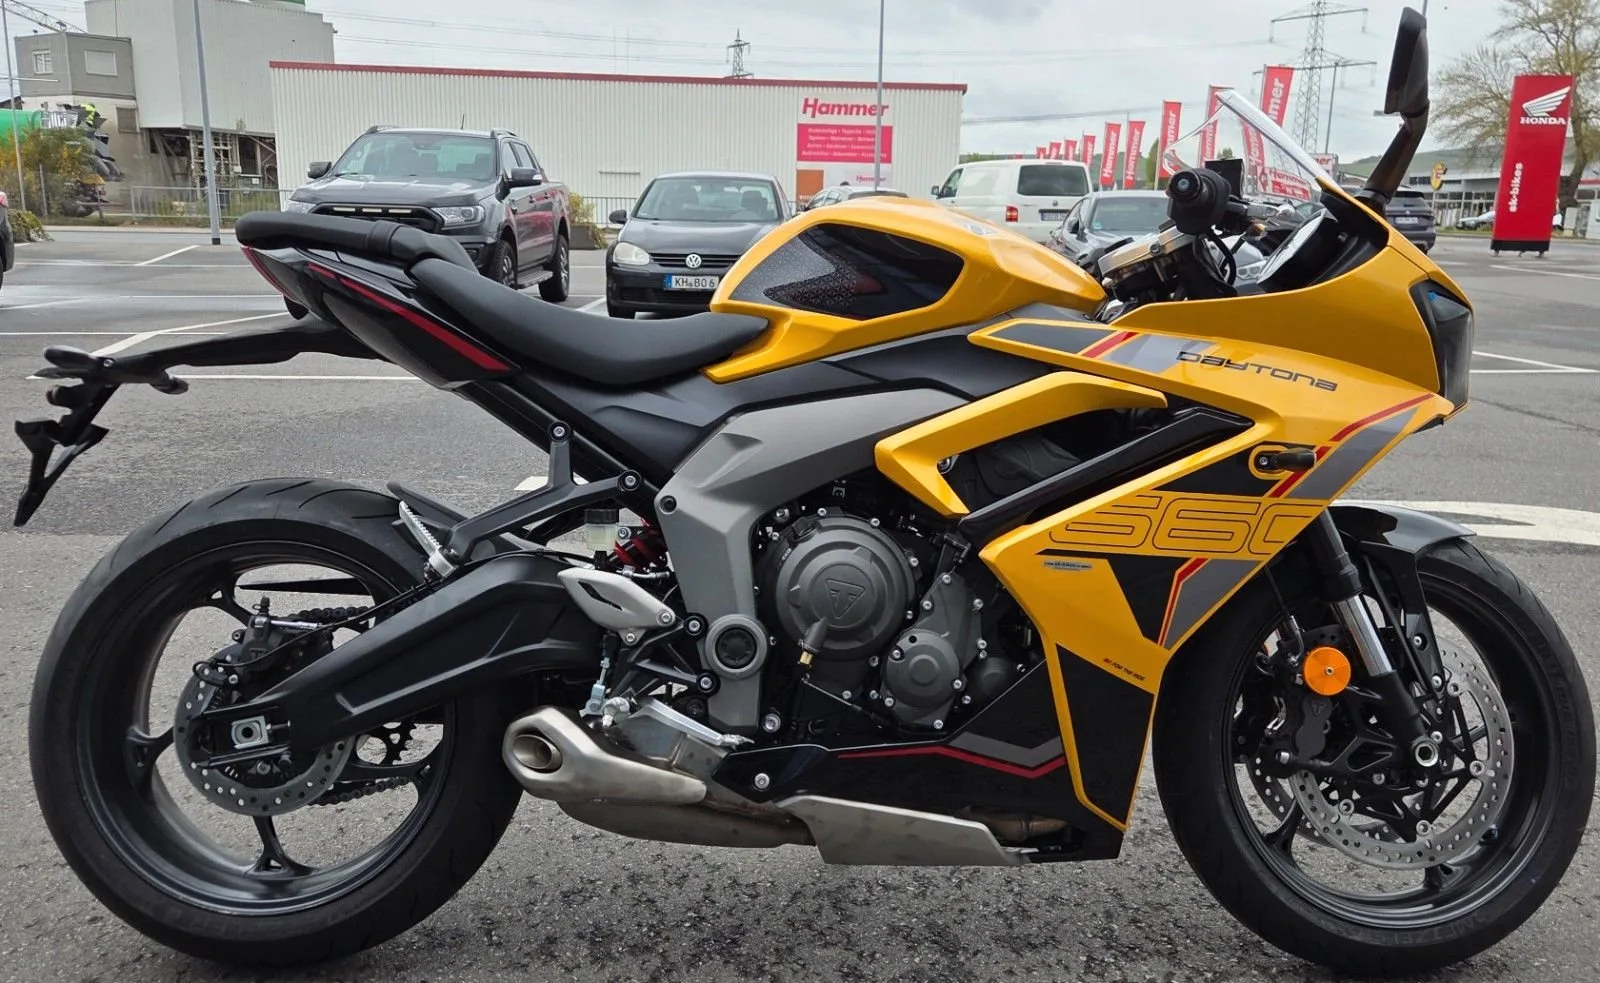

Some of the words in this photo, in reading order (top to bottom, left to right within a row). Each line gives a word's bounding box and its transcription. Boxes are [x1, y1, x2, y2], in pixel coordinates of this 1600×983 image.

[802, 97, 889, 118] Hammer
[1520, 116, 1567, 125] HONDA
[675, 277, 688, 287] KH
[709, 279, 715, 288] 6
